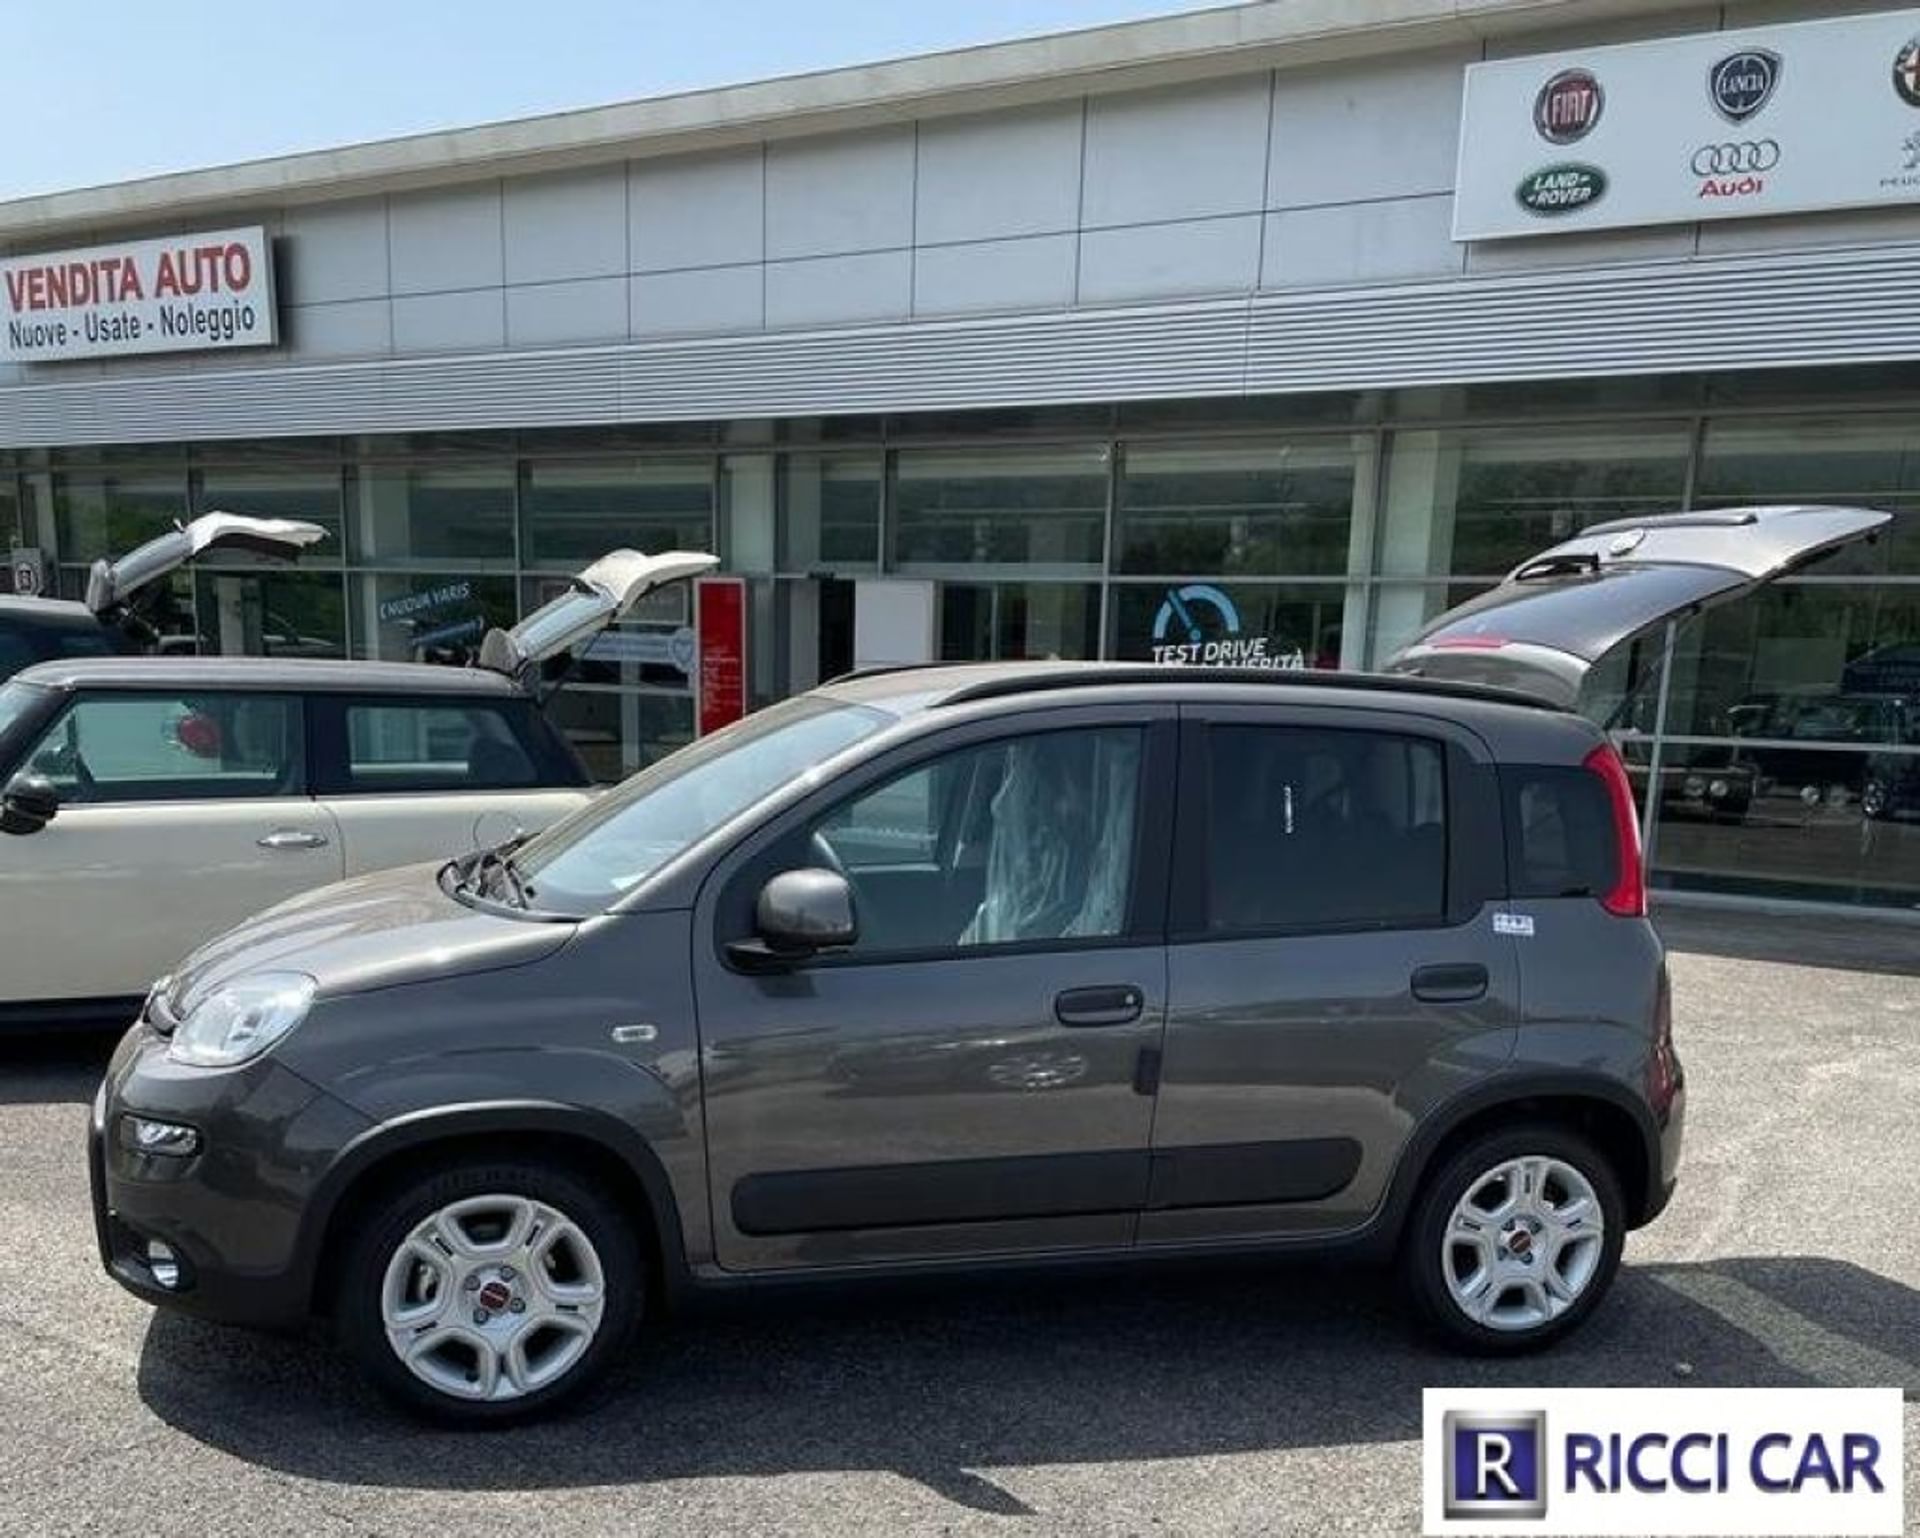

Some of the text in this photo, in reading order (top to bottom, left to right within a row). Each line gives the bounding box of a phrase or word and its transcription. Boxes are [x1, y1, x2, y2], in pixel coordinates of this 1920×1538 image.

[1552, 90, 1591, 125] FIAT
[1700, 178, 1762, 198] Audi
[5, 242, 250, 312] VENDITA AUTO
[9, 321, 66, 348] Nuove
[85, 311, 140, 341] Usate
[160, 300, 255, 341] Noleggio
[1152, 643, 1201, 664] TEST
[1204, 638, 1268, 661] DRIVE
